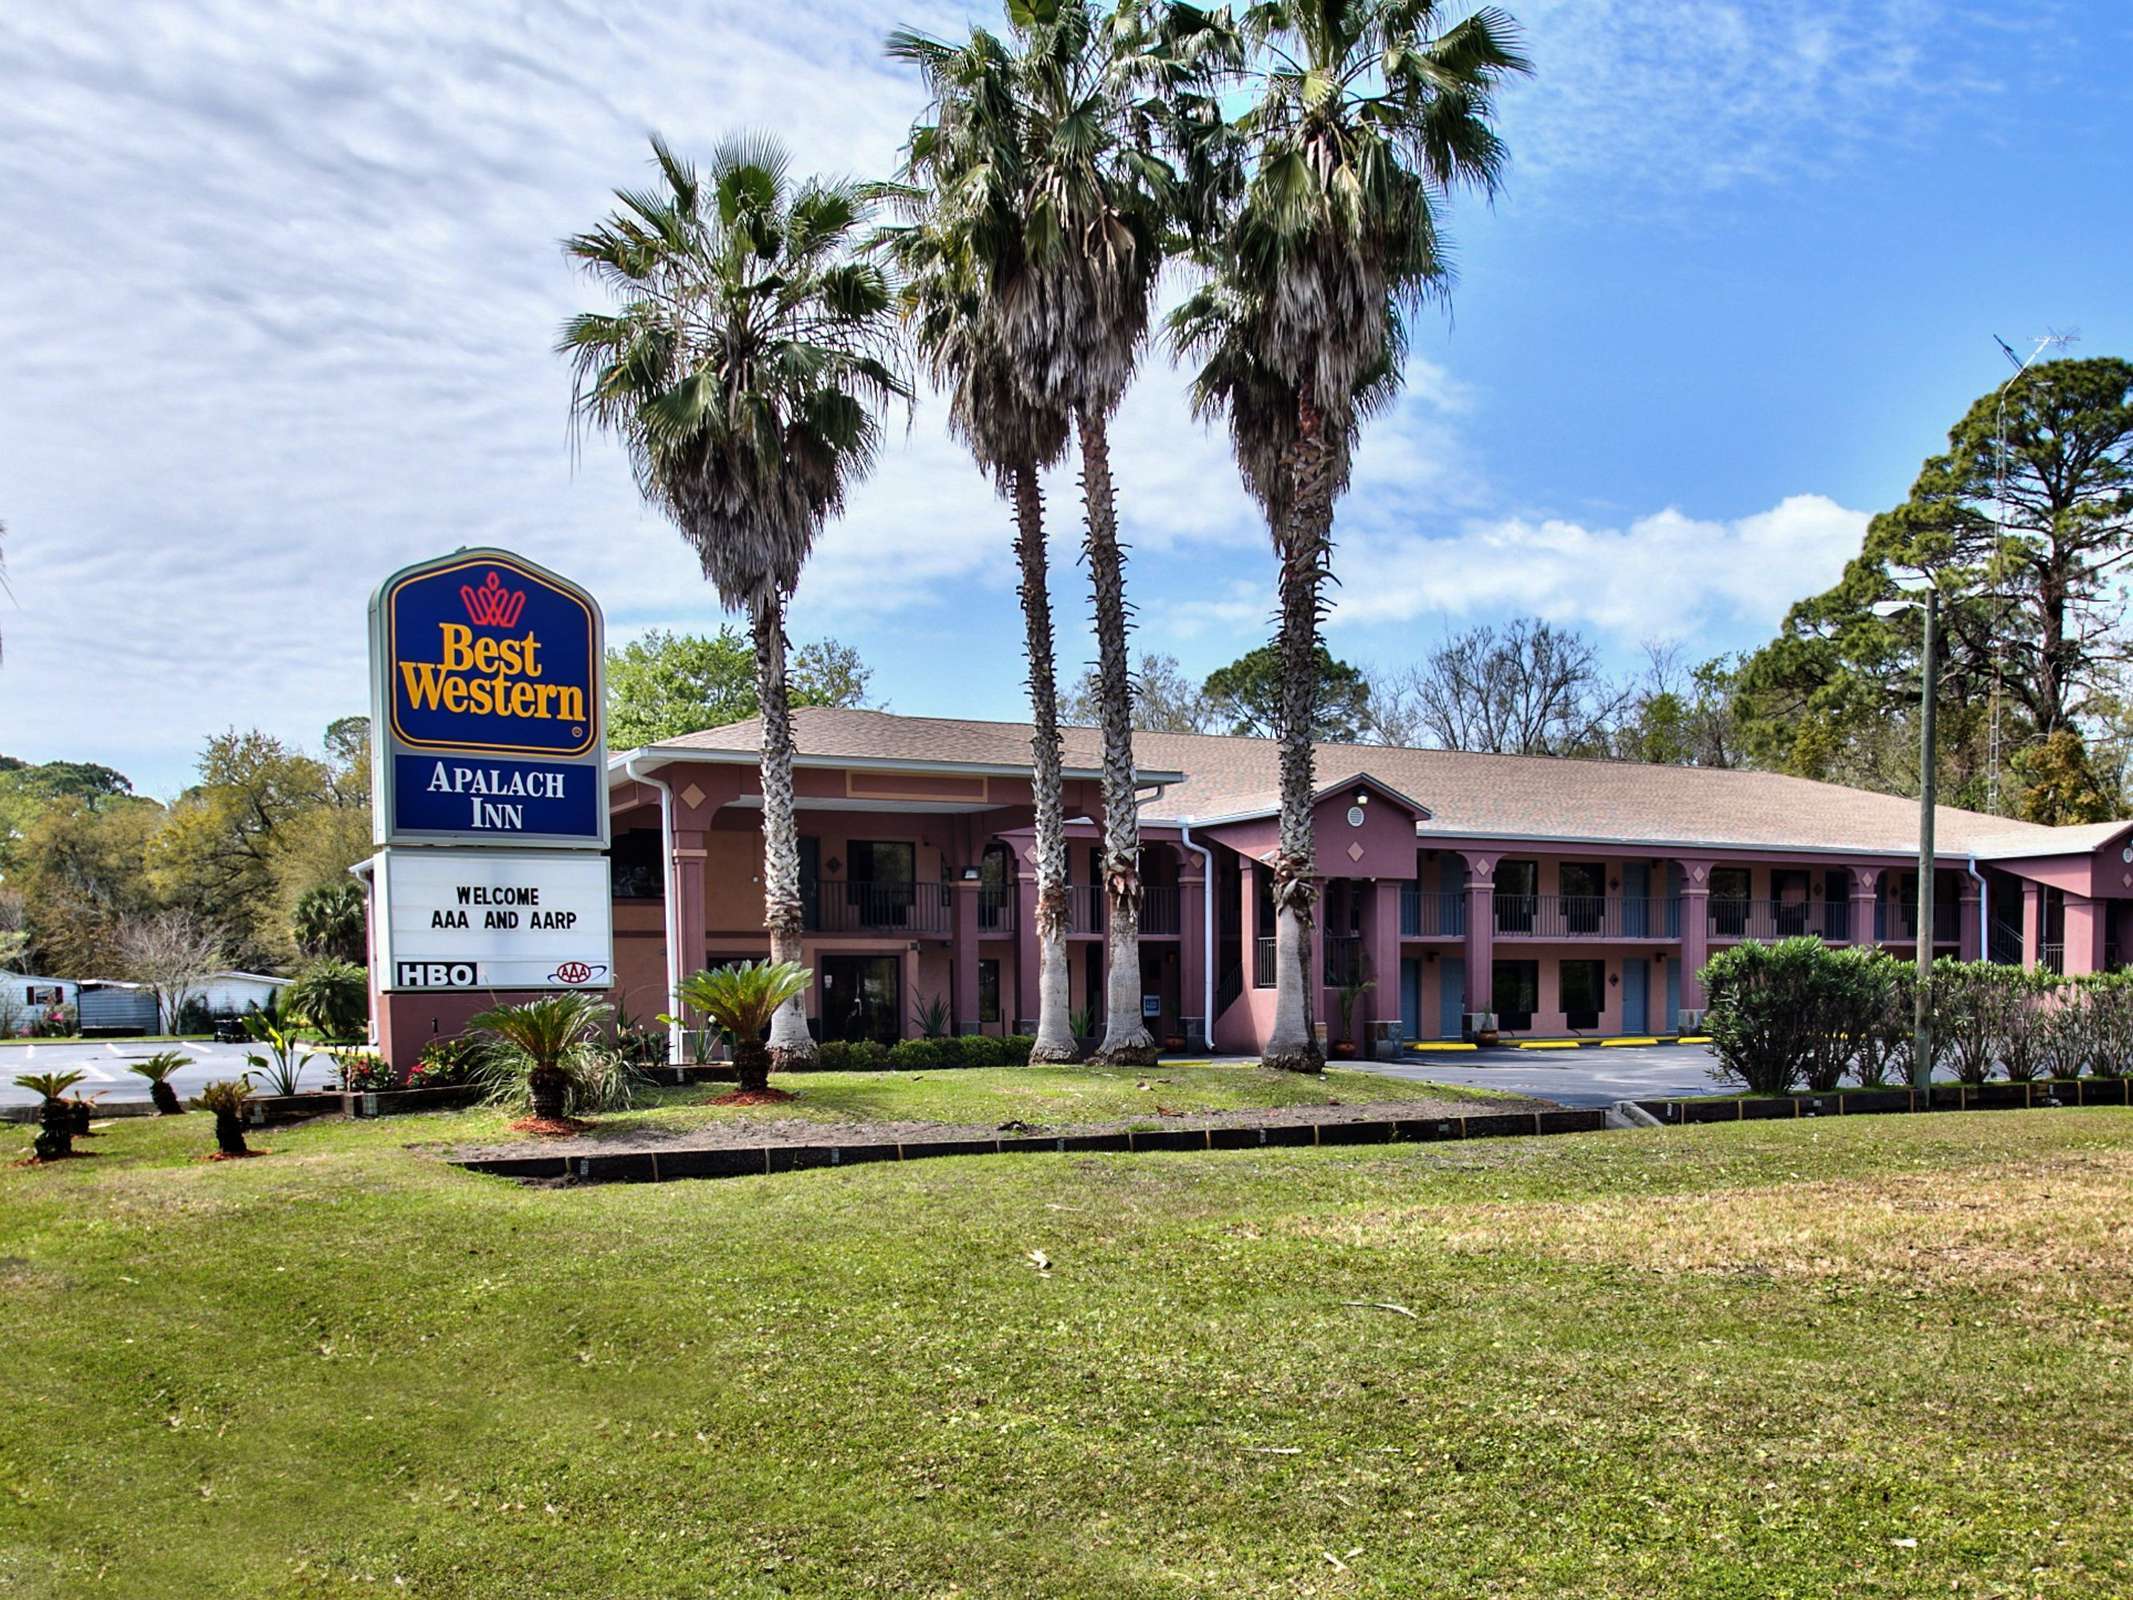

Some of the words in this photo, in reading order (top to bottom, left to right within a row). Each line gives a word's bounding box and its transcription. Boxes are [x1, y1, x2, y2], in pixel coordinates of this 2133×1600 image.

[439, 622, 542, 677] Best
[399, 661, 586, 721] Western
[426, 761, 565, 798] APALACH
[470, 797, 523, 829] INN
[456, 886, 539, 905] WELCOME
[431, 910, 470, 929] AAA
[484, 911, 519, 929] AND
[530, 911, 577, 929] AARP
[402, 964, 473, 986] HBO
[560, 962, 589, 983] AAA
